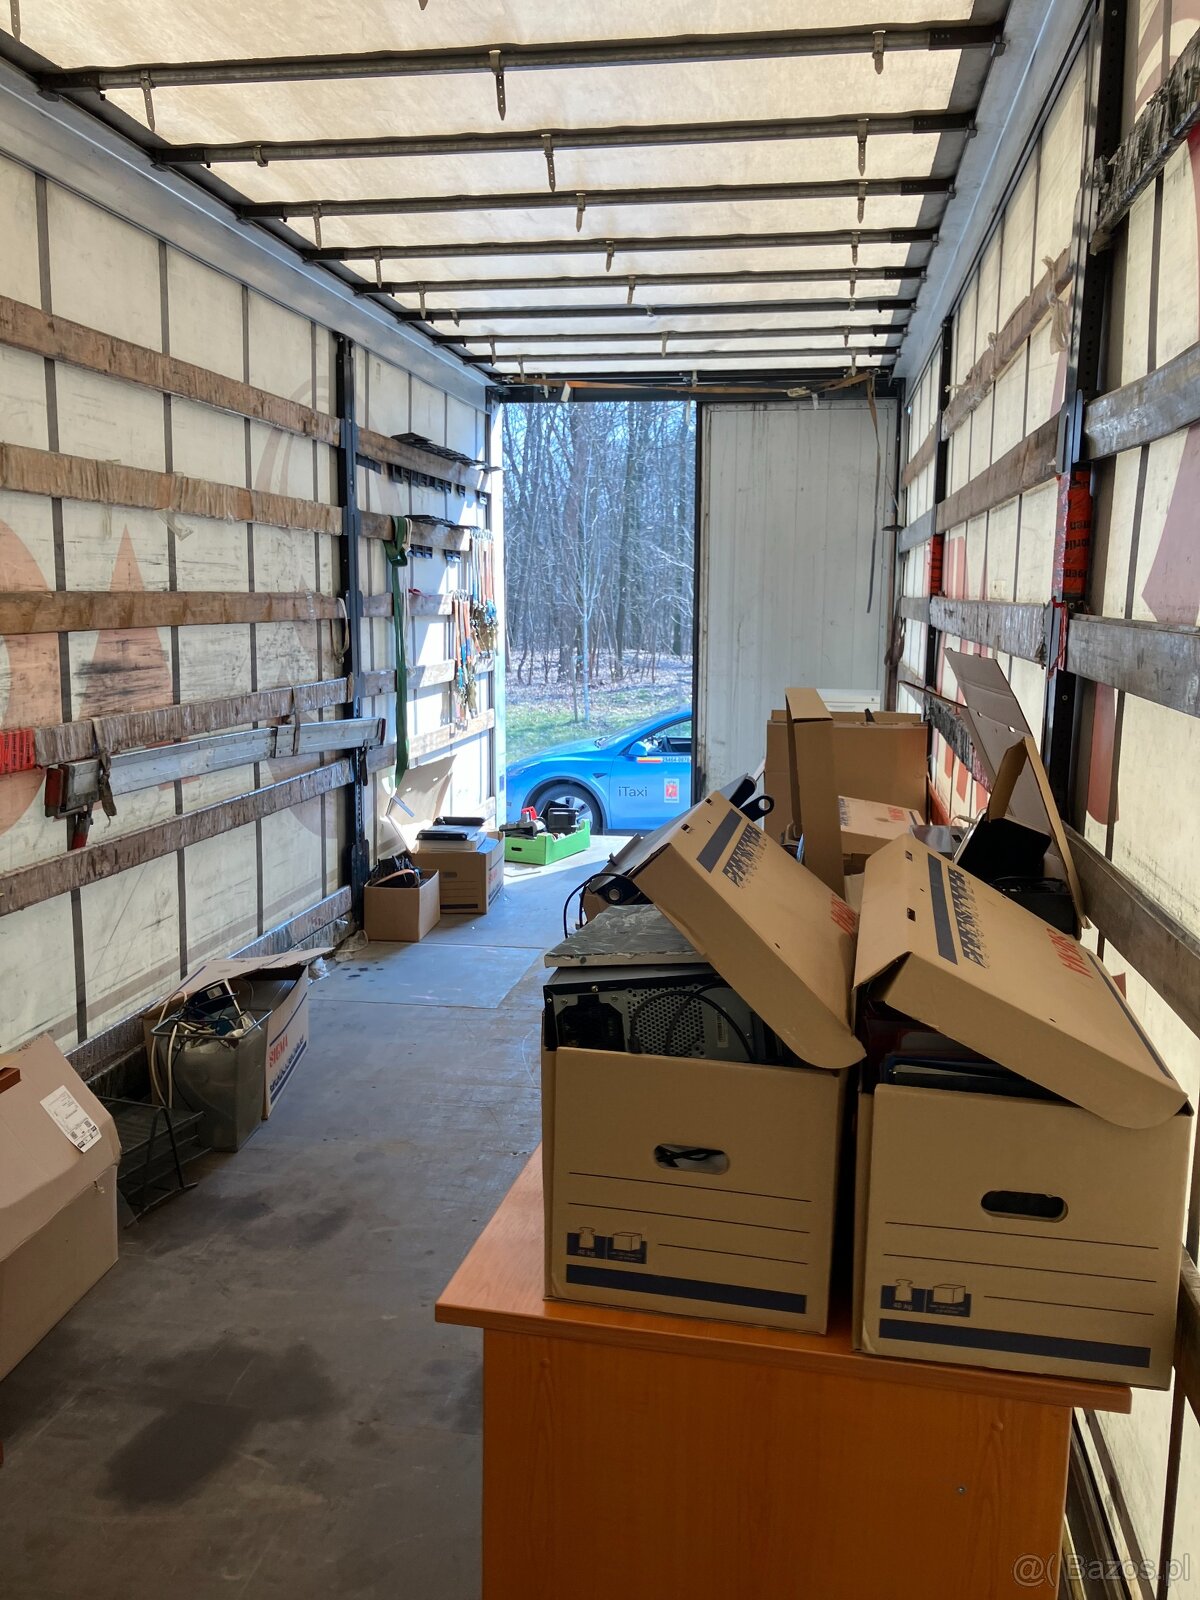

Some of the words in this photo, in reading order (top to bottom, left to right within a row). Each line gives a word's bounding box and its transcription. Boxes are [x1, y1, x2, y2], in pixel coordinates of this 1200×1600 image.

[618, 786, 648, 797] iTaxi
[1046, 927, 1094, 979] SIGMA
[269, 1034, 288, 1068] SIGMA
